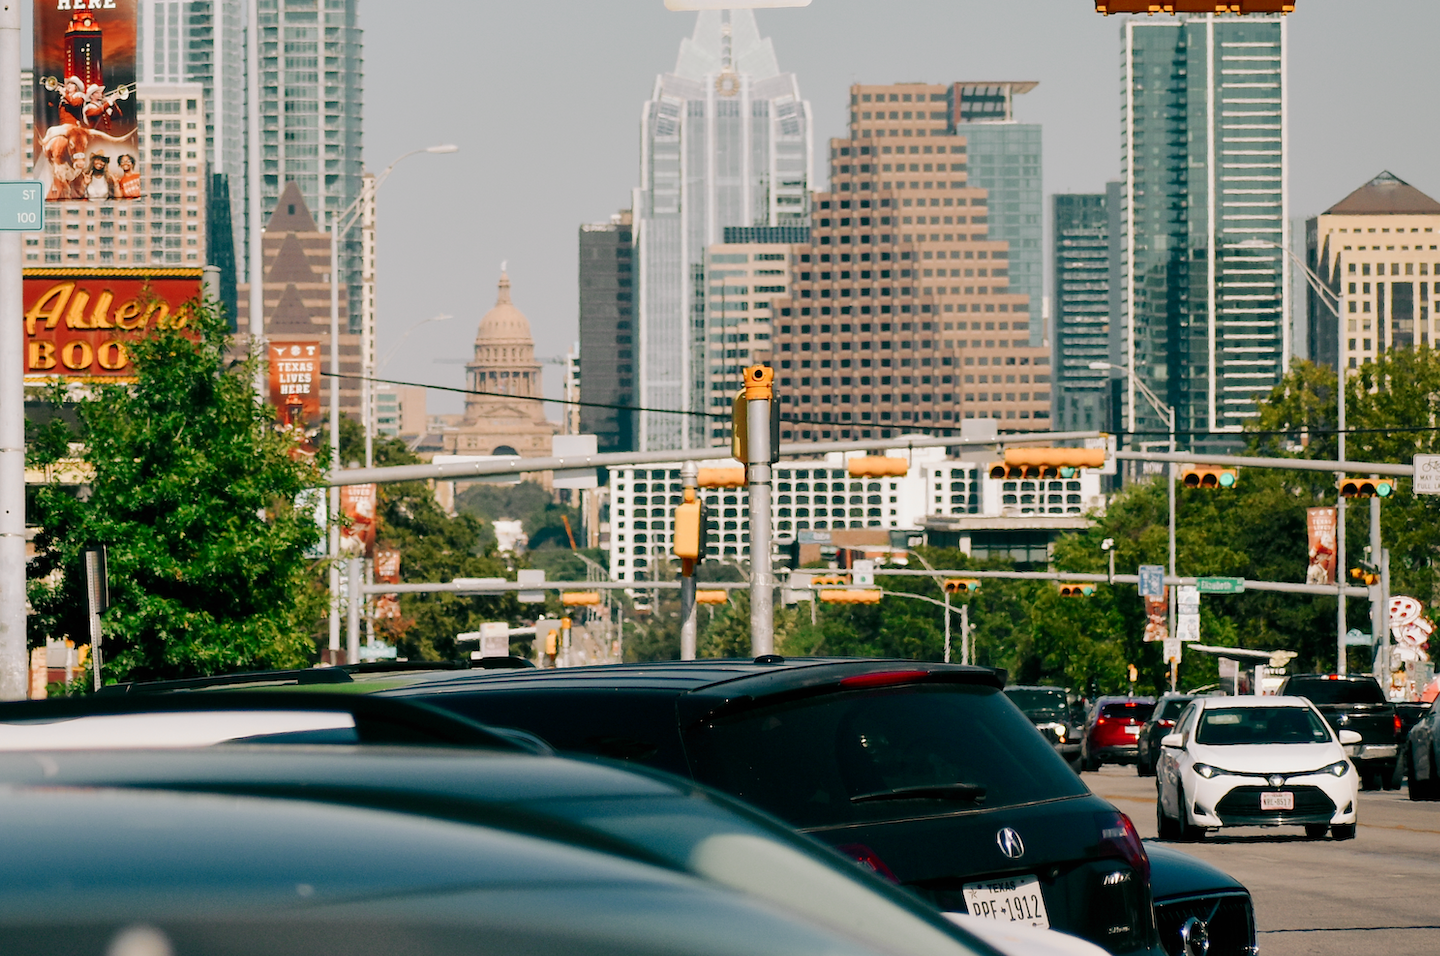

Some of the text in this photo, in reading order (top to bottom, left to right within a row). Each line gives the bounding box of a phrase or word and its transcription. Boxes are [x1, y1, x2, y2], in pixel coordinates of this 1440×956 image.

[22, 189, 36, 200] ST
[17, 212, 36, 223] 100
[28, 339, 129, 371] BOO
[277, 362, 313, 372] TEXAS
[279, 373, 312, 383] LIVES
[280, 384, 311, 394] HERE
[987, 880, 1016, 893] TEXAS
